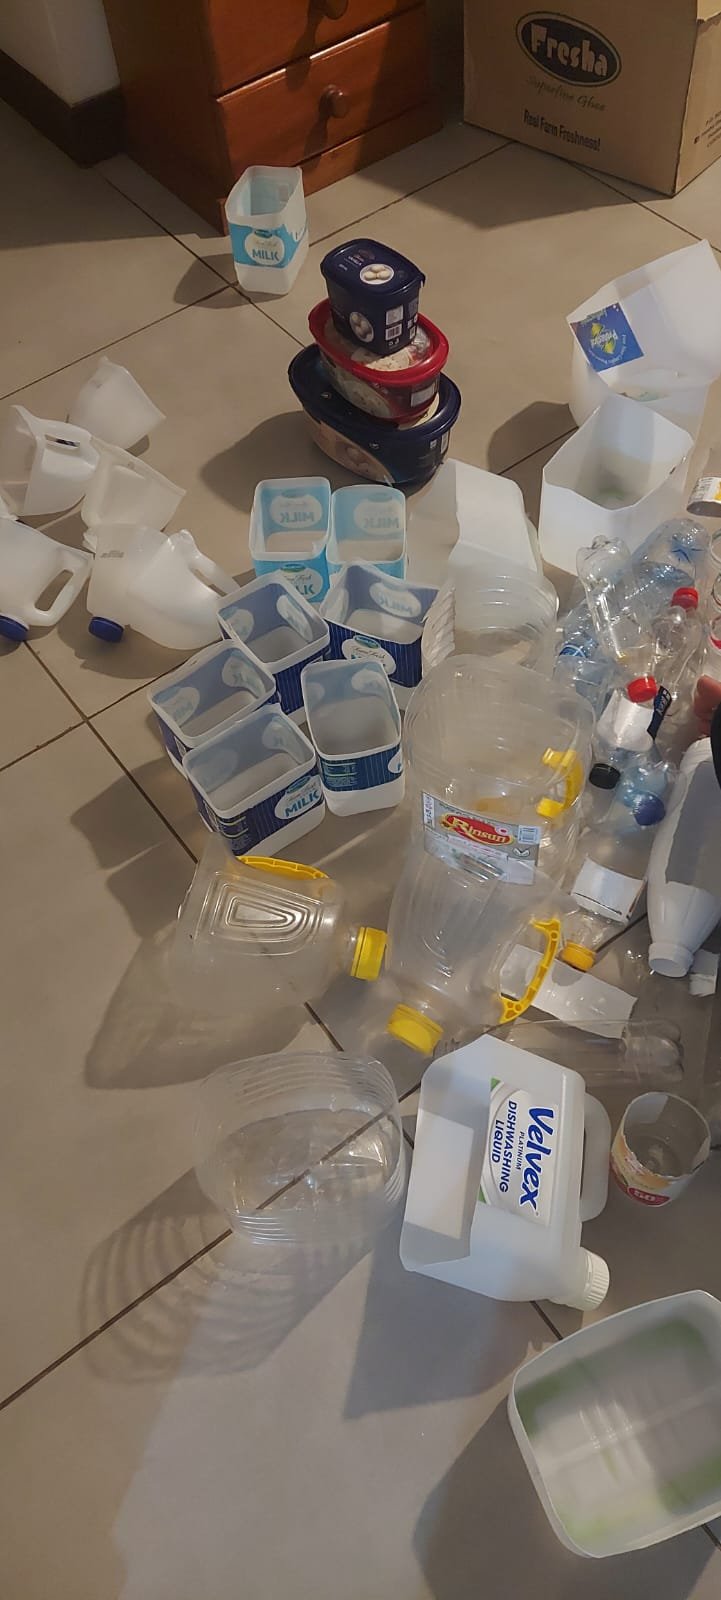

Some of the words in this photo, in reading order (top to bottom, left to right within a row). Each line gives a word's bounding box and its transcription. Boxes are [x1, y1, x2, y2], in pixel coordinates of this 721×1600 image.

[530, 23, 608, 77] Fresha
[523, 108, 539, 128] Real
[540, 116, 558, 137] Farm
[559, 124, 601, 152] Freshness!
[252, 247, 279, 262] MILK
[284, 789, 320, 818] MILK
[452, 816, 507, 844] Rinsun
[491, 1119, 505, 1163] LIQUID
[499, 1100, 518, 1193] DISHWASHING
[515, 1131, 525, 1170] PLATINUM
[519, 1107, 554, 1210] Velvex
